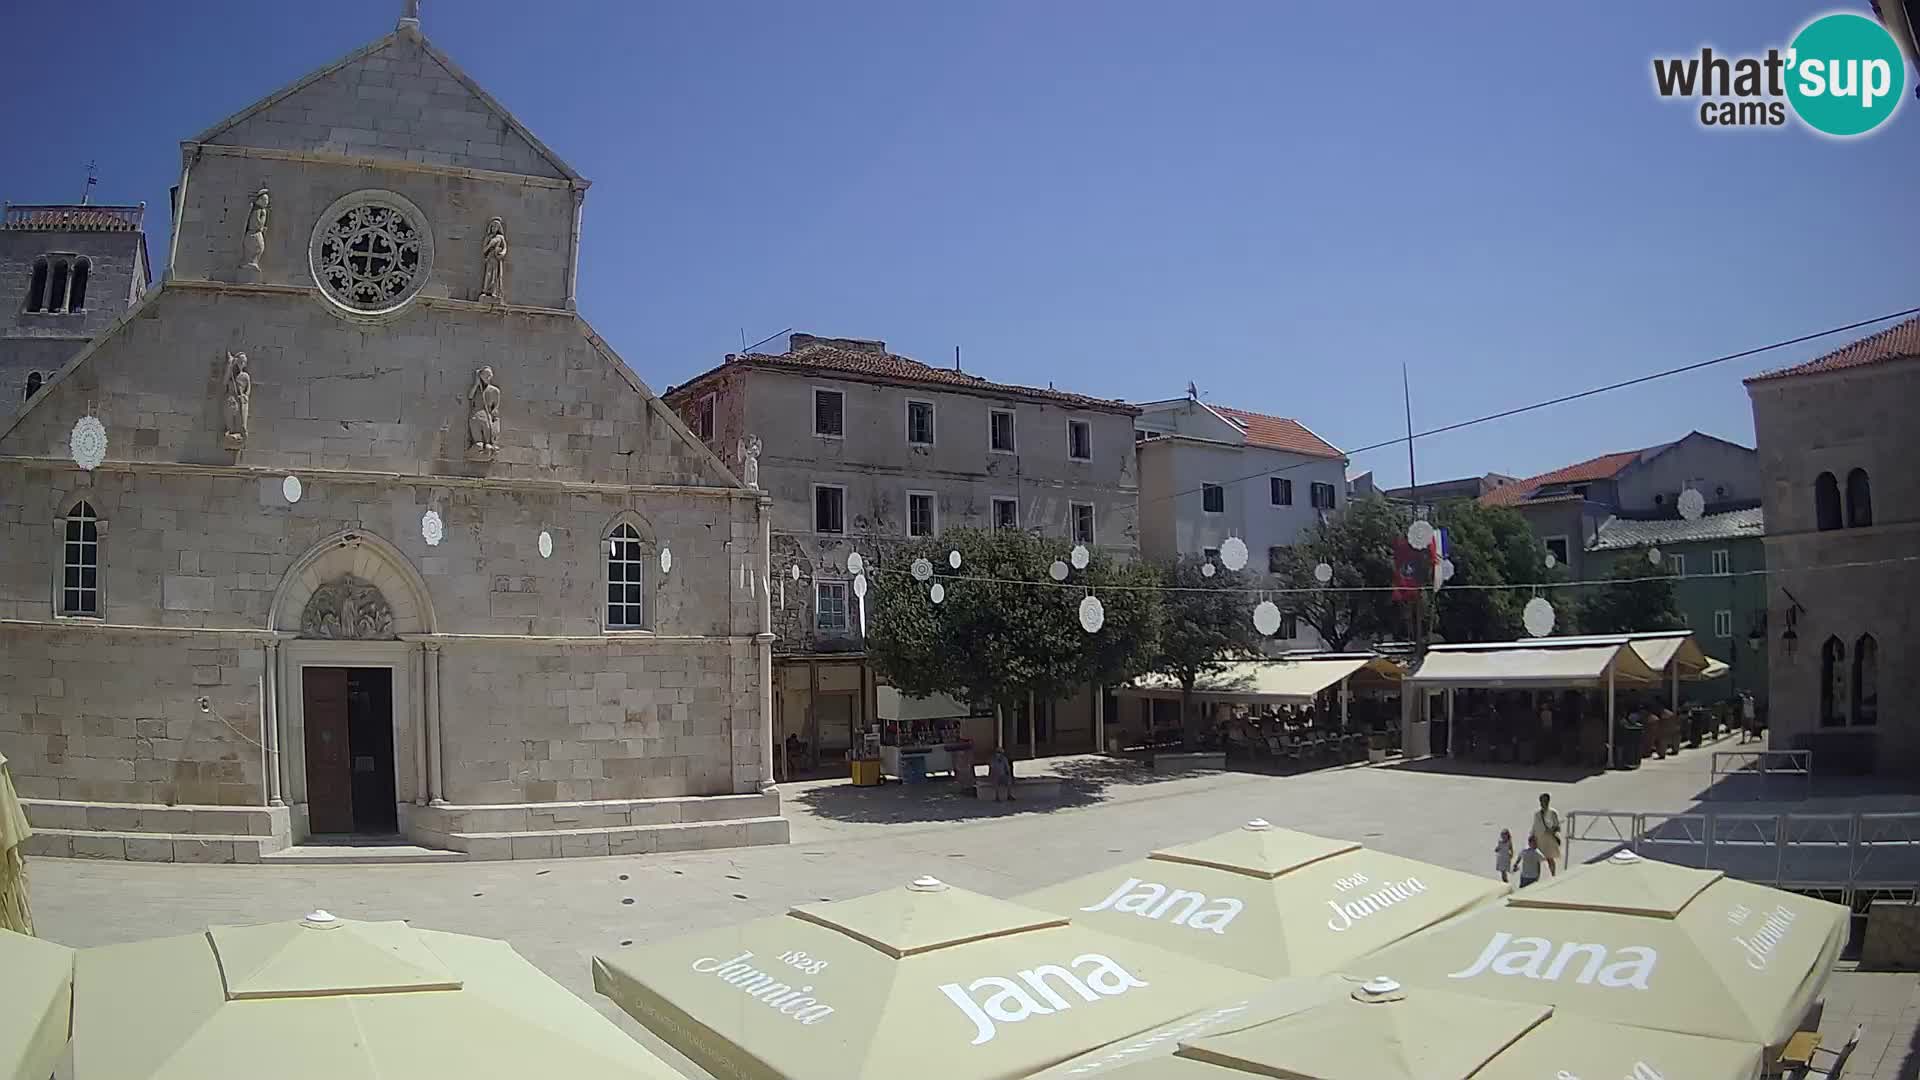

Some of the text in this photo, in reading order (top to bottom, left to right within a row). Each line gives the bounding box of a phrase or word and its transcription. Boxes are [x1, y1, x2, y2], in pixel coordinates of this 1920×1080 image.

[1080, 878, 1244, 935] Jana
[1327, 877, 1426, 931] Jamnica
[692, 950, 834, 1025] Jamnica
[776, 951, 828, 975] 1828
[1447, 932, 1658, 990] Jana
[937, 953, 1149, 1045] Jana
